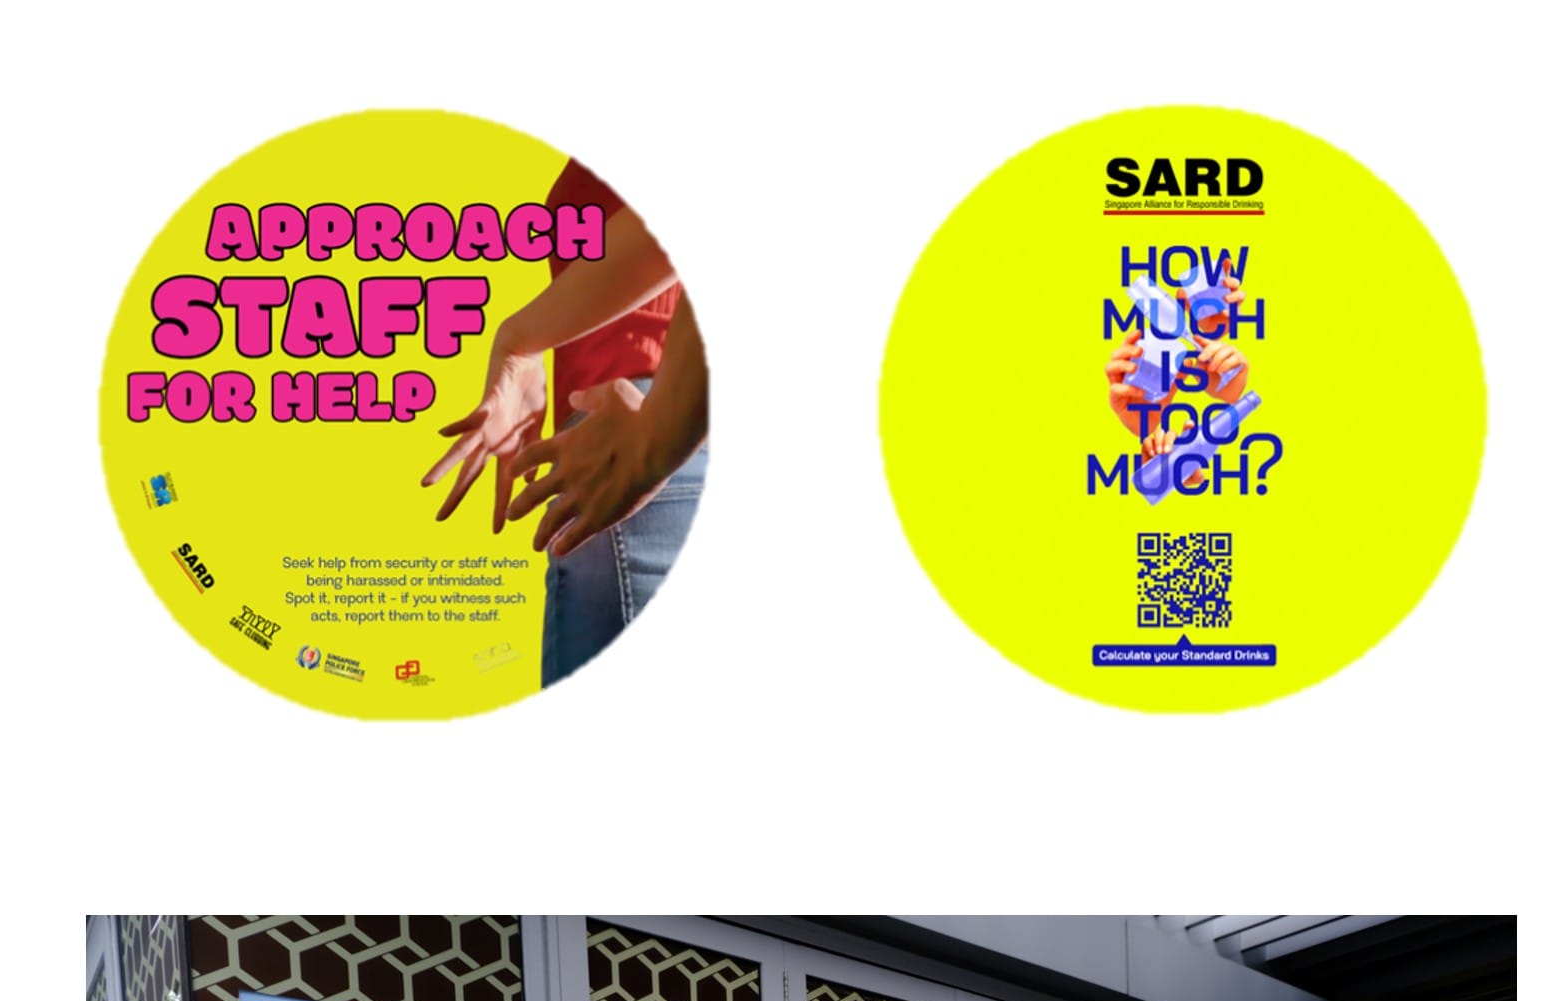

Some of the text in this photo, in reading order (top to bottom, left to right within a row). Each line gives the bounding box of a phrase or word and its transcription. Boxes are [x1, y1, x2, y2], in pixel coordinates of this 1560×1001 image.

[1105, 157, 1264, 198] SARD
[1104, 200, 1264, 210] Singapore Alliance for Responsible Drinking
[205, 202, 606, 262] APPROACH
[1120, 245, 1249, 288] HOW
[150, 274, 491, 360] STAFF
[1102, 298, 1265, 341] MUCH
[1160, 350, 1209, 394] IS
[126, 371, 436, 423] FOR HELP
[1127, 402, 1240, 446] TOO
[1087, 433, 1284, 497] MUCH?
[177, 542, 216, 589] SARD
[282, 556, 529, 571] Seek help from security or staff when
[306, 574, 505, 589] being harassed or intimidated.
[285, 592, 527, 607] Spot it, report it if you witness such
[310, 609, 501, 625] acts, report them to the staff.
[1099, 650, 1270, 664] Calculate your Standard Drinks
